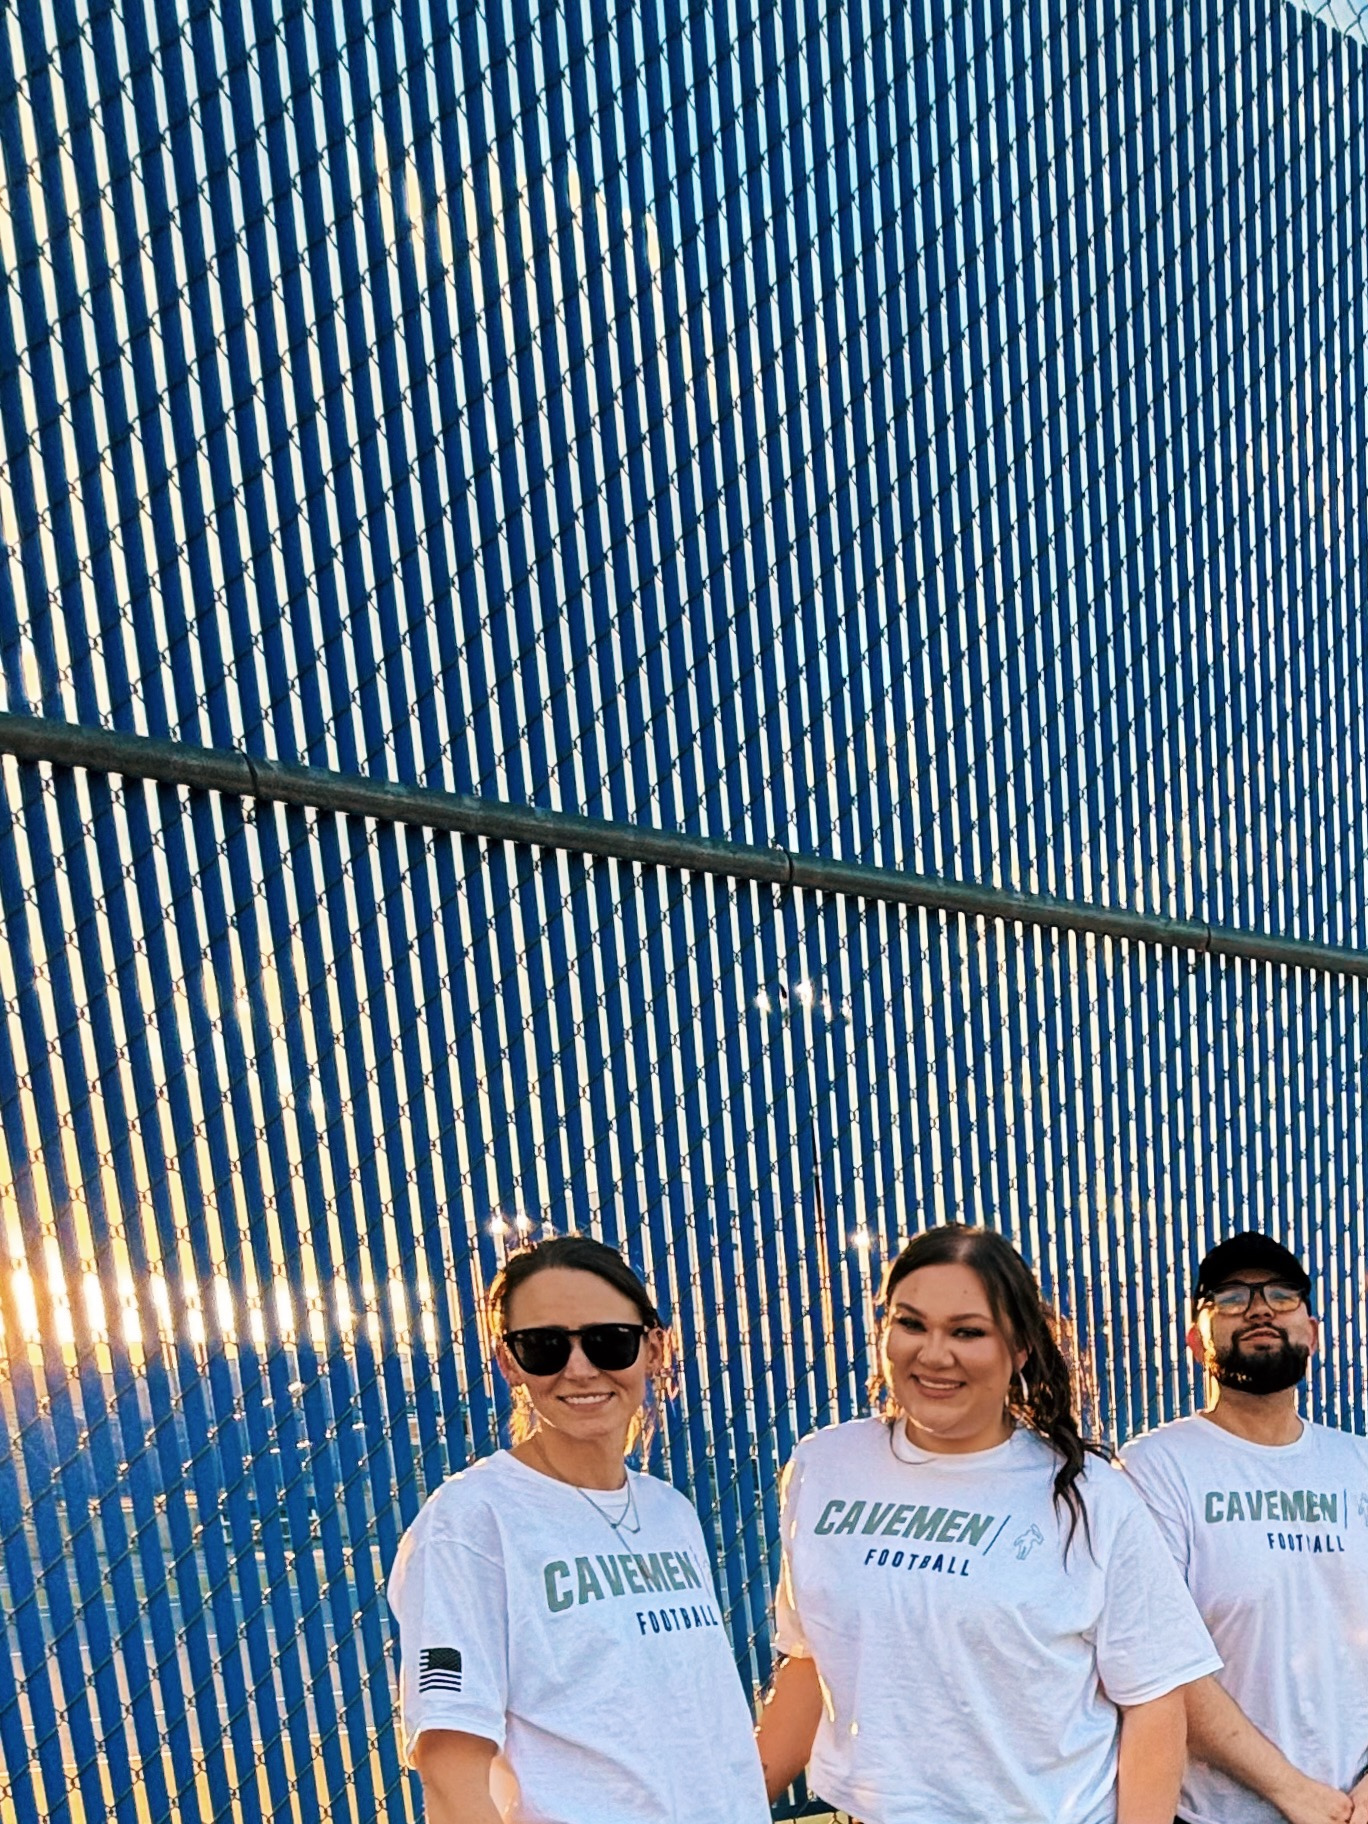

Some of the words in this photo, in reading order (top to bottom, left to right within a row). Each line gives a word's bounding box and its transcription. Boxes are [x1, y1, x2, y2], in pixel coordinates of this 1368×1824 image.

[813, 1499, 995, 1547] CAVEMEN
[1205, 1489, 1338, 1524] CAVEMEN
[864, 1549, 971, 1577] FOOTBALL
[543, 1551, 702, 1613] CAVEMEN
[636, 1605, 719, 1635] FOOTBALL
